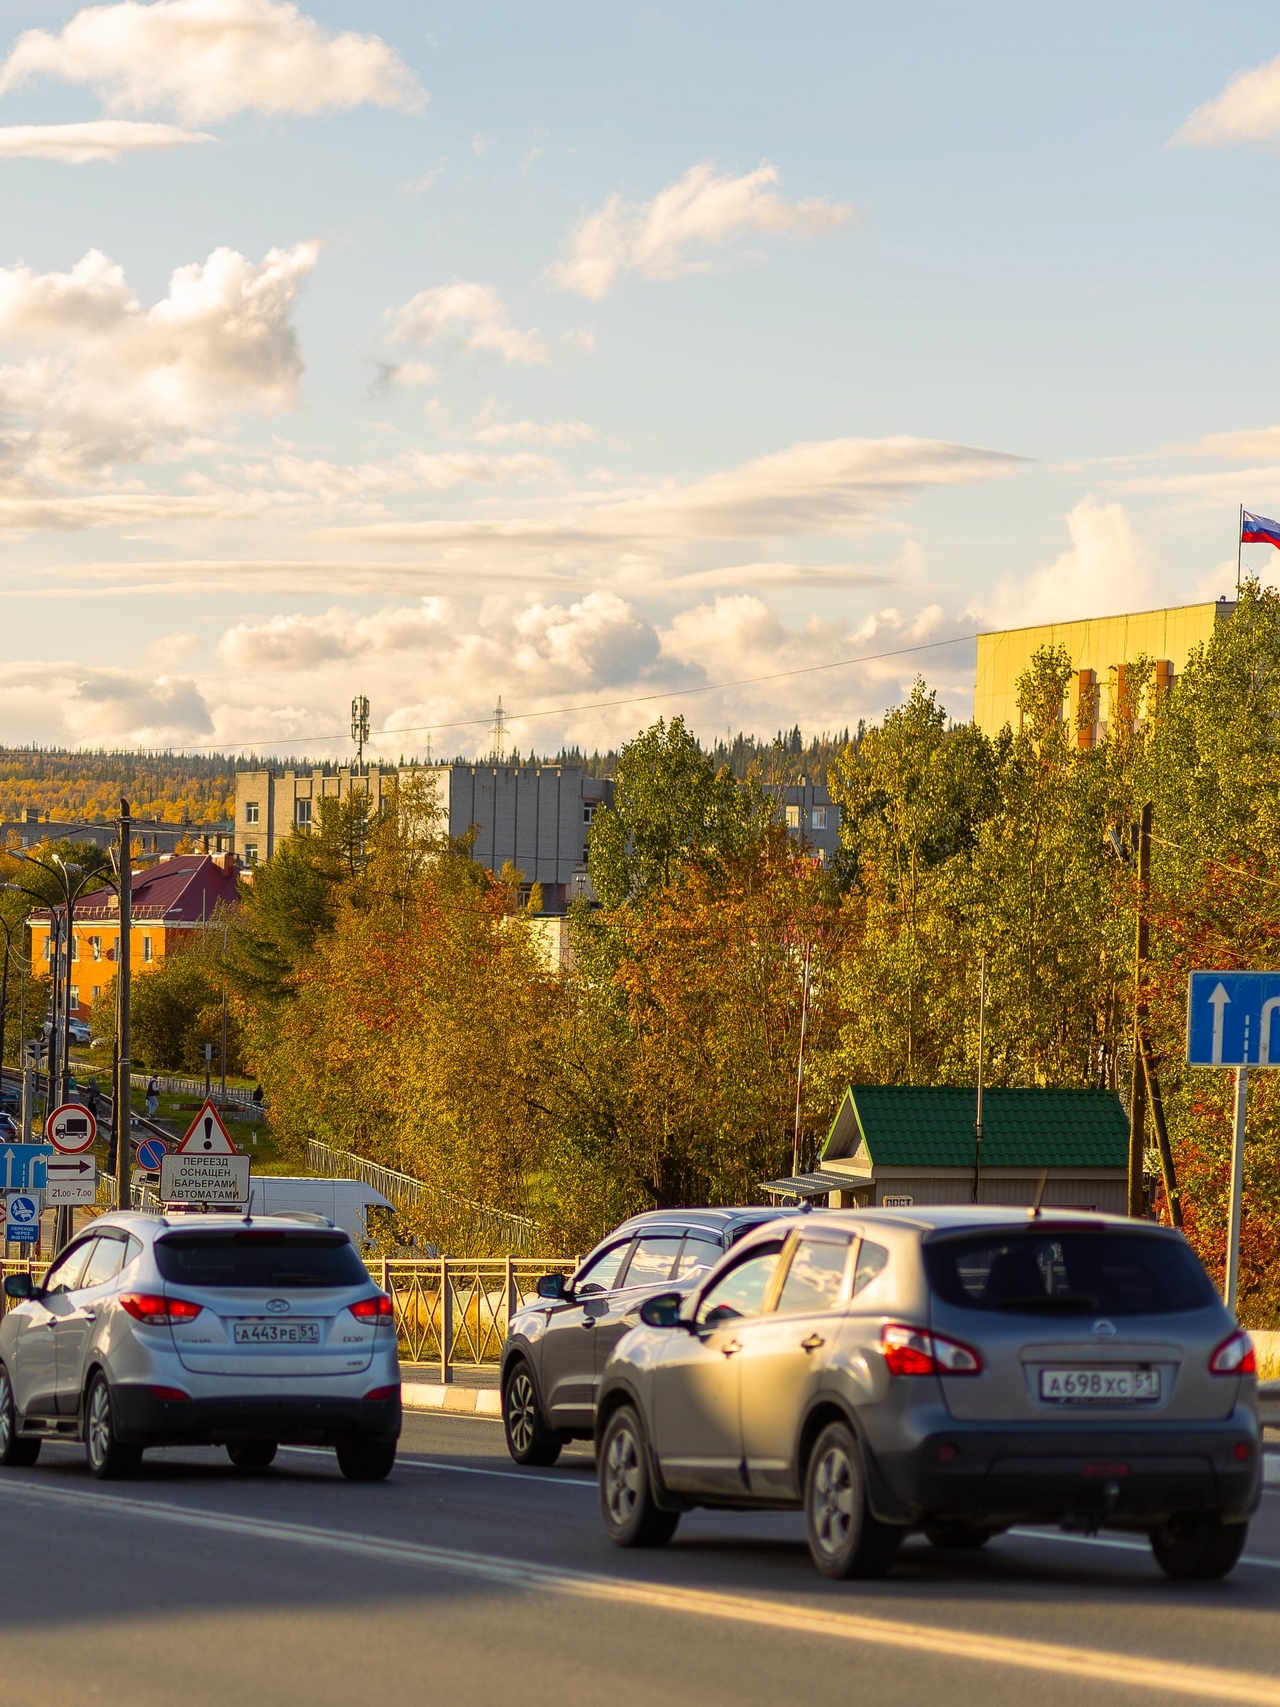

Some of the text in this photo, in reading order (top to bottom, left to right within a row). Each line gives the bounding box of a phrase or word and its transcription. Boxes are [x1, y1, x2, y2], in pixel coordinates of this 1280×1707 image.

[183, 1157, 229, 1168] ПЕРЕЕЗД
[180, 1168, 231, 1179] ОСНАЩЕН
[174, 1179, 236, 1188] БАРЬЕРАМИ
[170, 1190, 240, 1200] АВТОМАТАМИ
[886, 1198, 912, 1207] ПОСТ
[240, 1326, 315, 1340] А443РЕ 51
[1050, 1374, 1155, 1394] А698ХС 51
